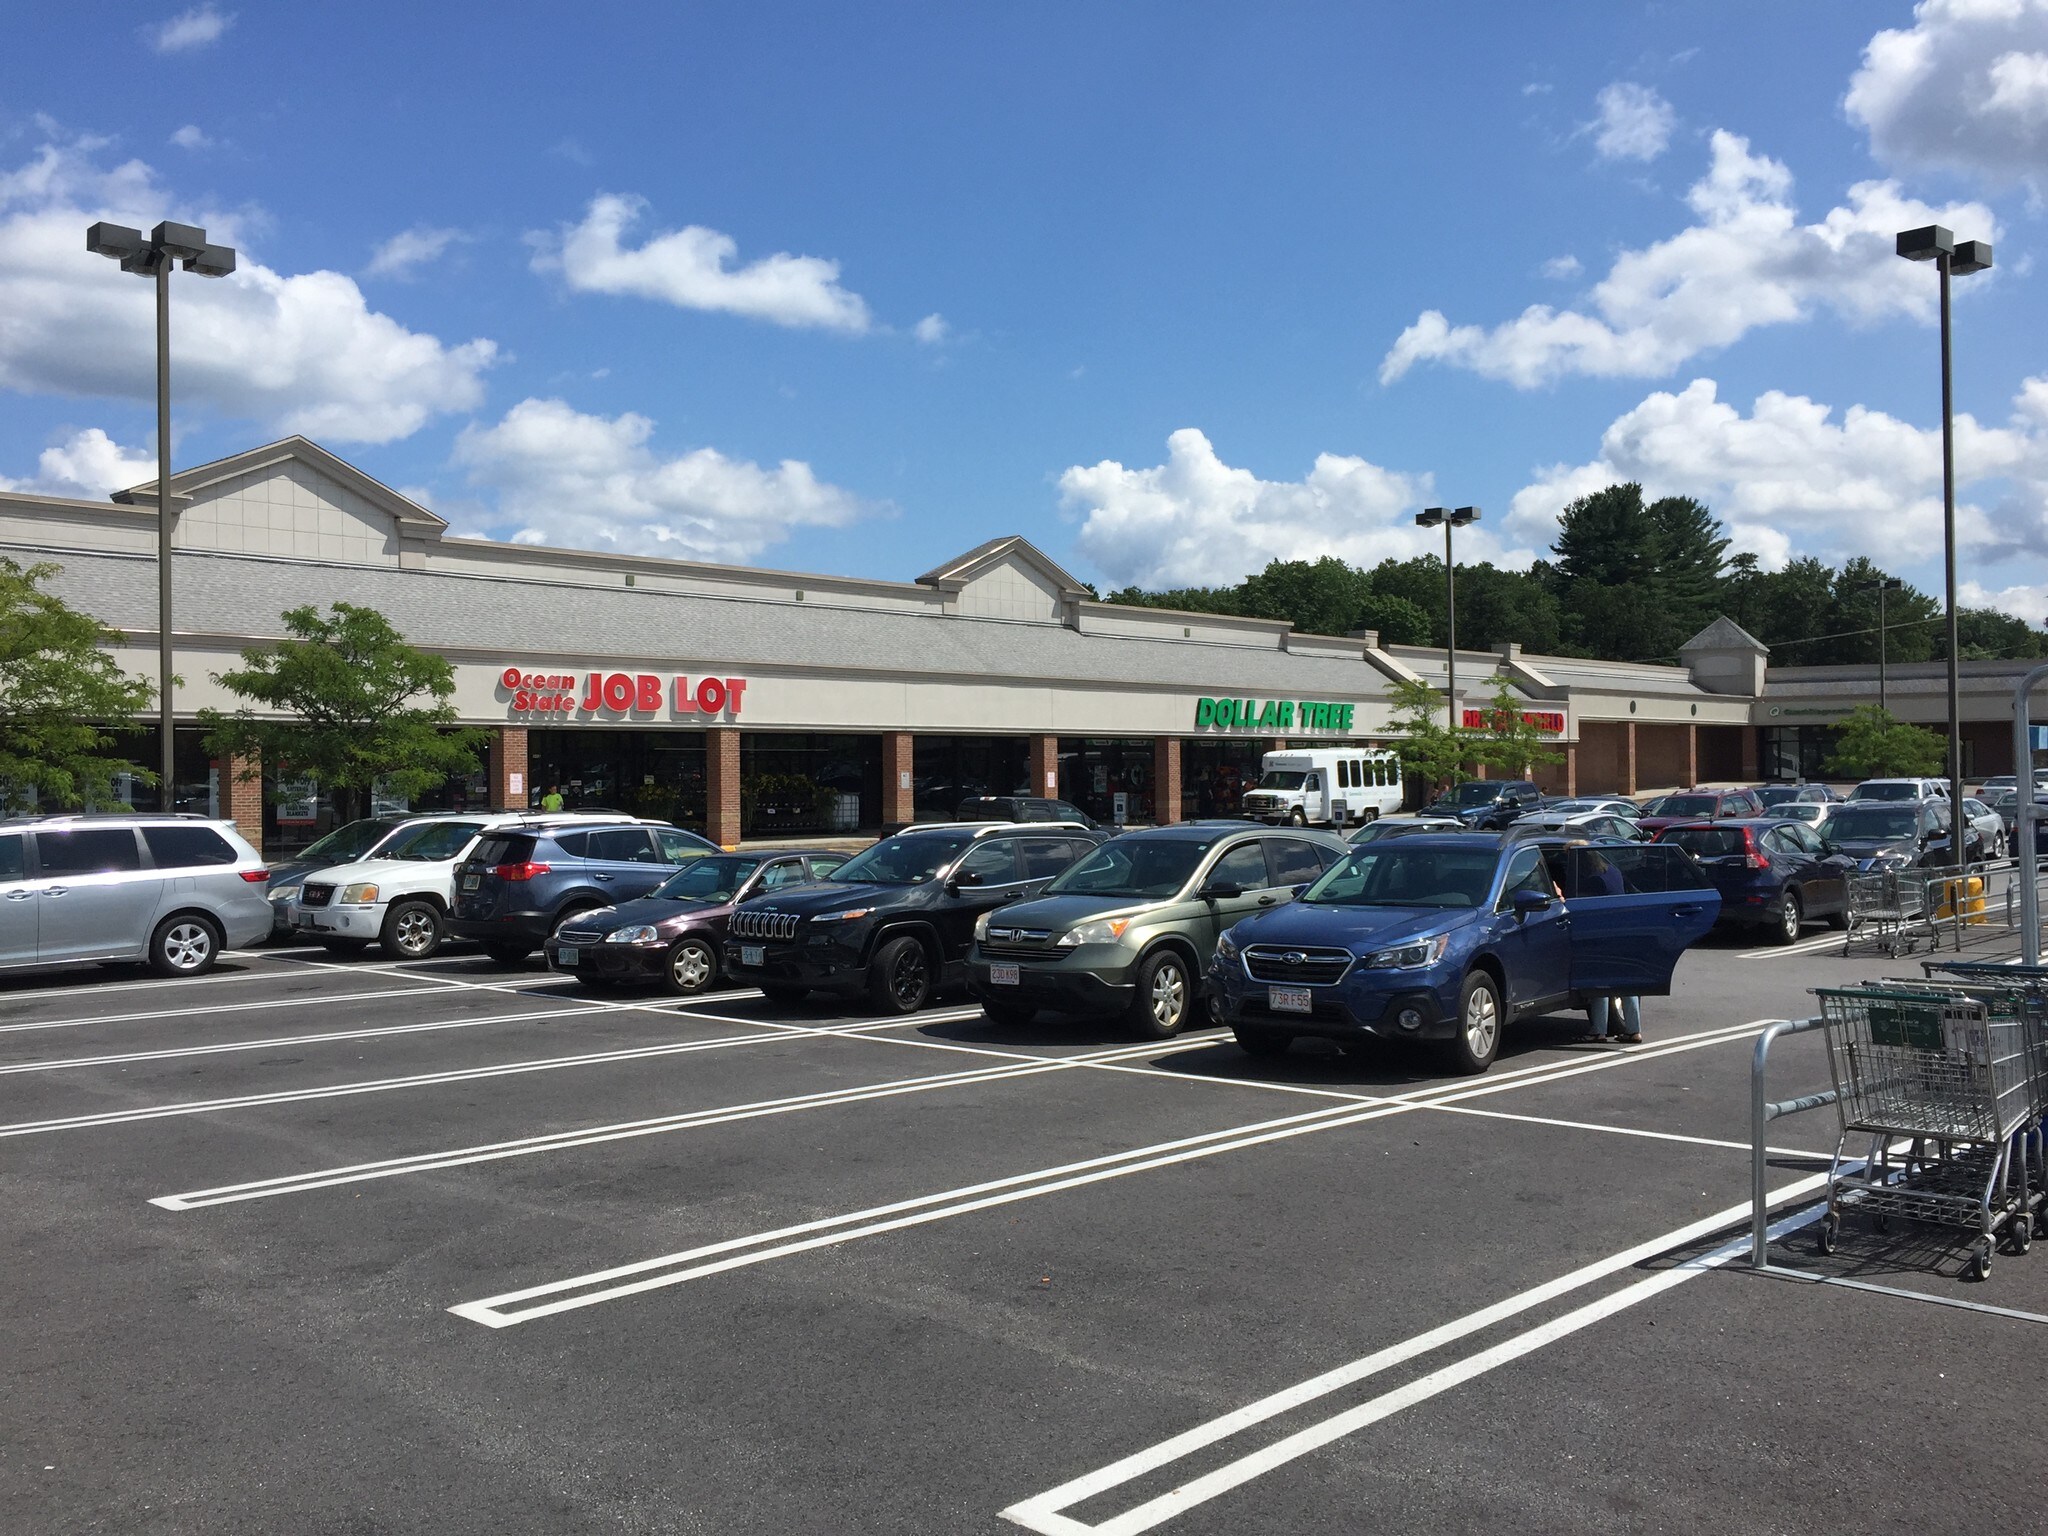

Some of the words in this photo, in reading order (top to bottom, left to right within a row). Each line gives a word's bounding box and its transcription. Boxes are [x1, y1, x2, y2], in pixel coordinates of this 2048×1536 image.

[503, 668, 575, 690] Ocean
[512, 690, 576, 713] State
[581, 673, 663, 712] JOB
[673, 676, 747, 715] LOT
[1196, 698, 1295, 728] DOLLAR
[1300, 702, 1355, 730] TREE
